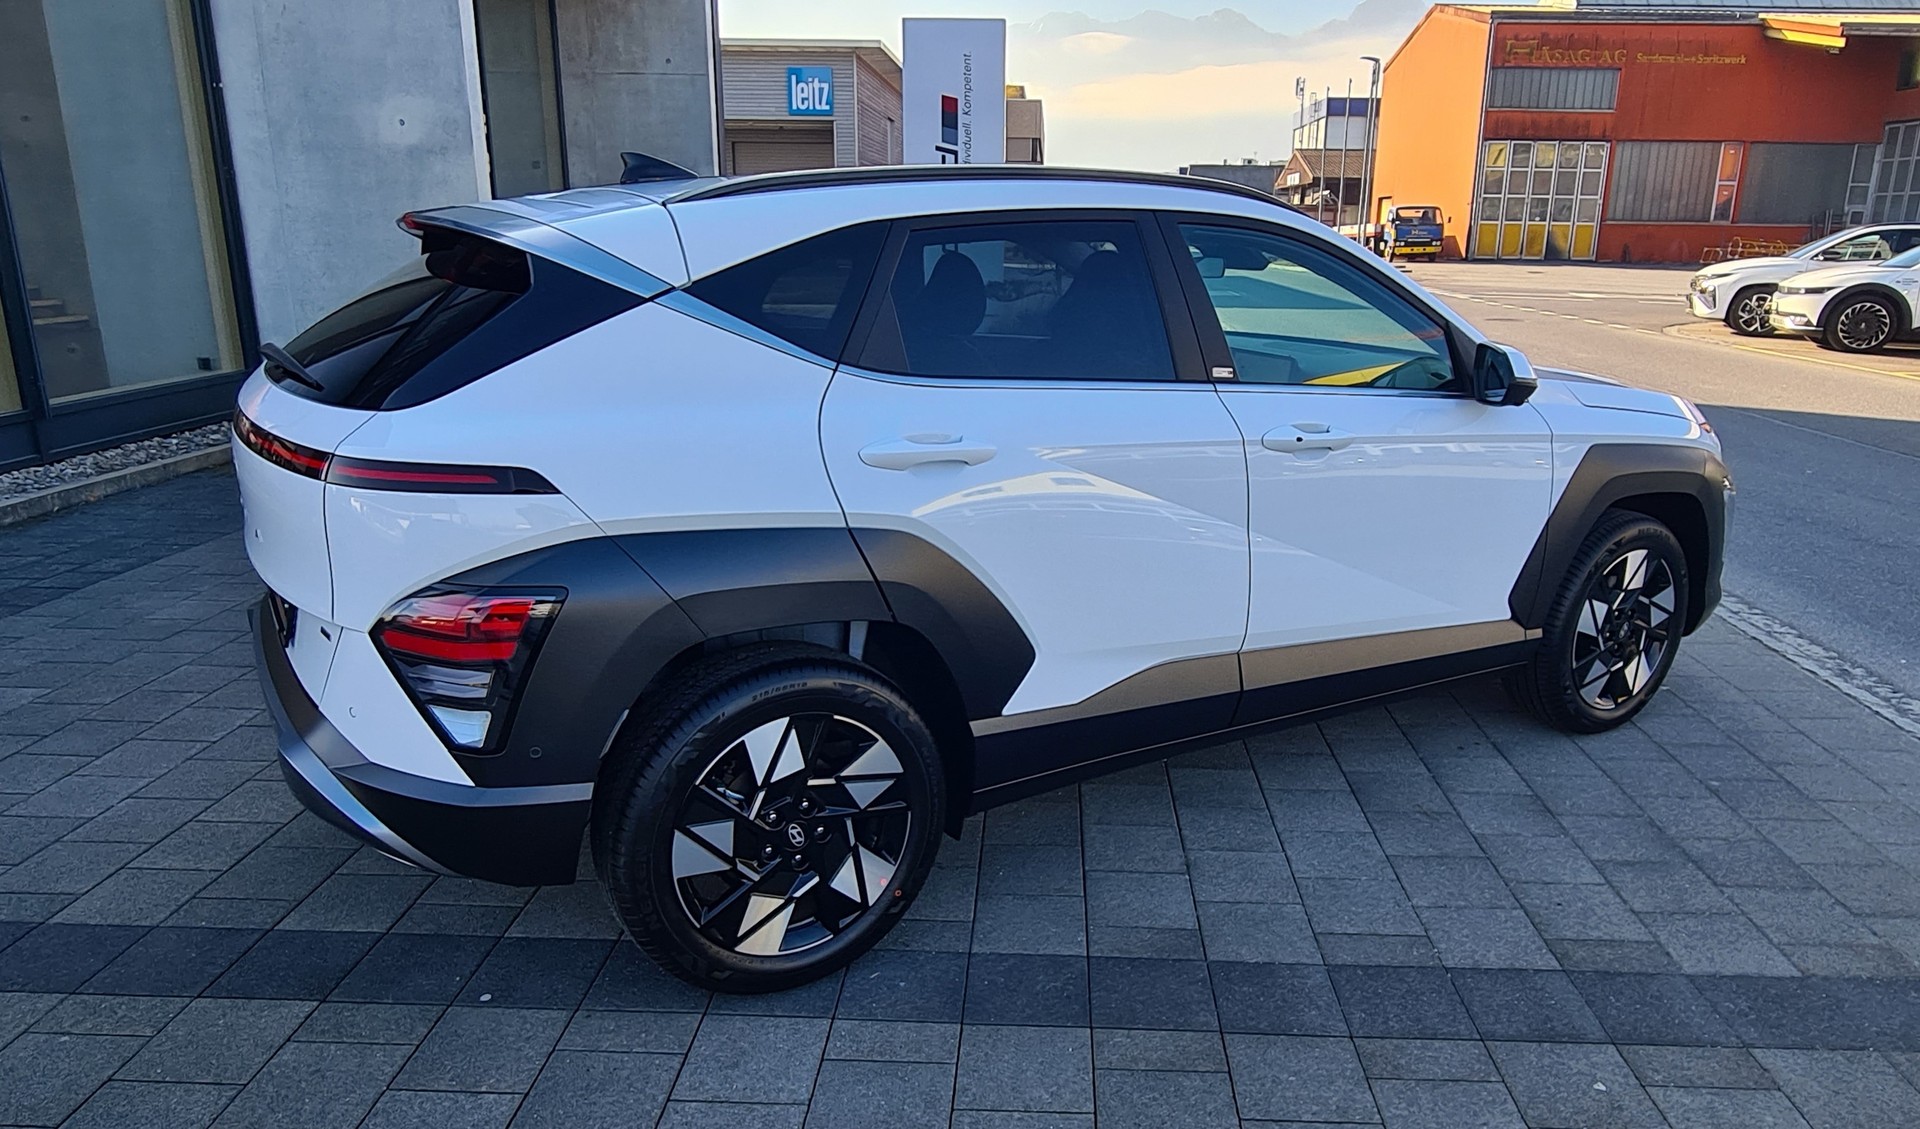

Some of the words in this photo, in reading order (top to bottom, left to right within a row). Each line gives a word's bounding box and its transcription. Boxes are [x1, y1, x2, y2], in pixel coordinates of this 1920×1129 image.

[1599, 49, 1628, 64] AG
[791, 74, 830, 111] leitz
[961, 51, 974, 117] Kompetent.
